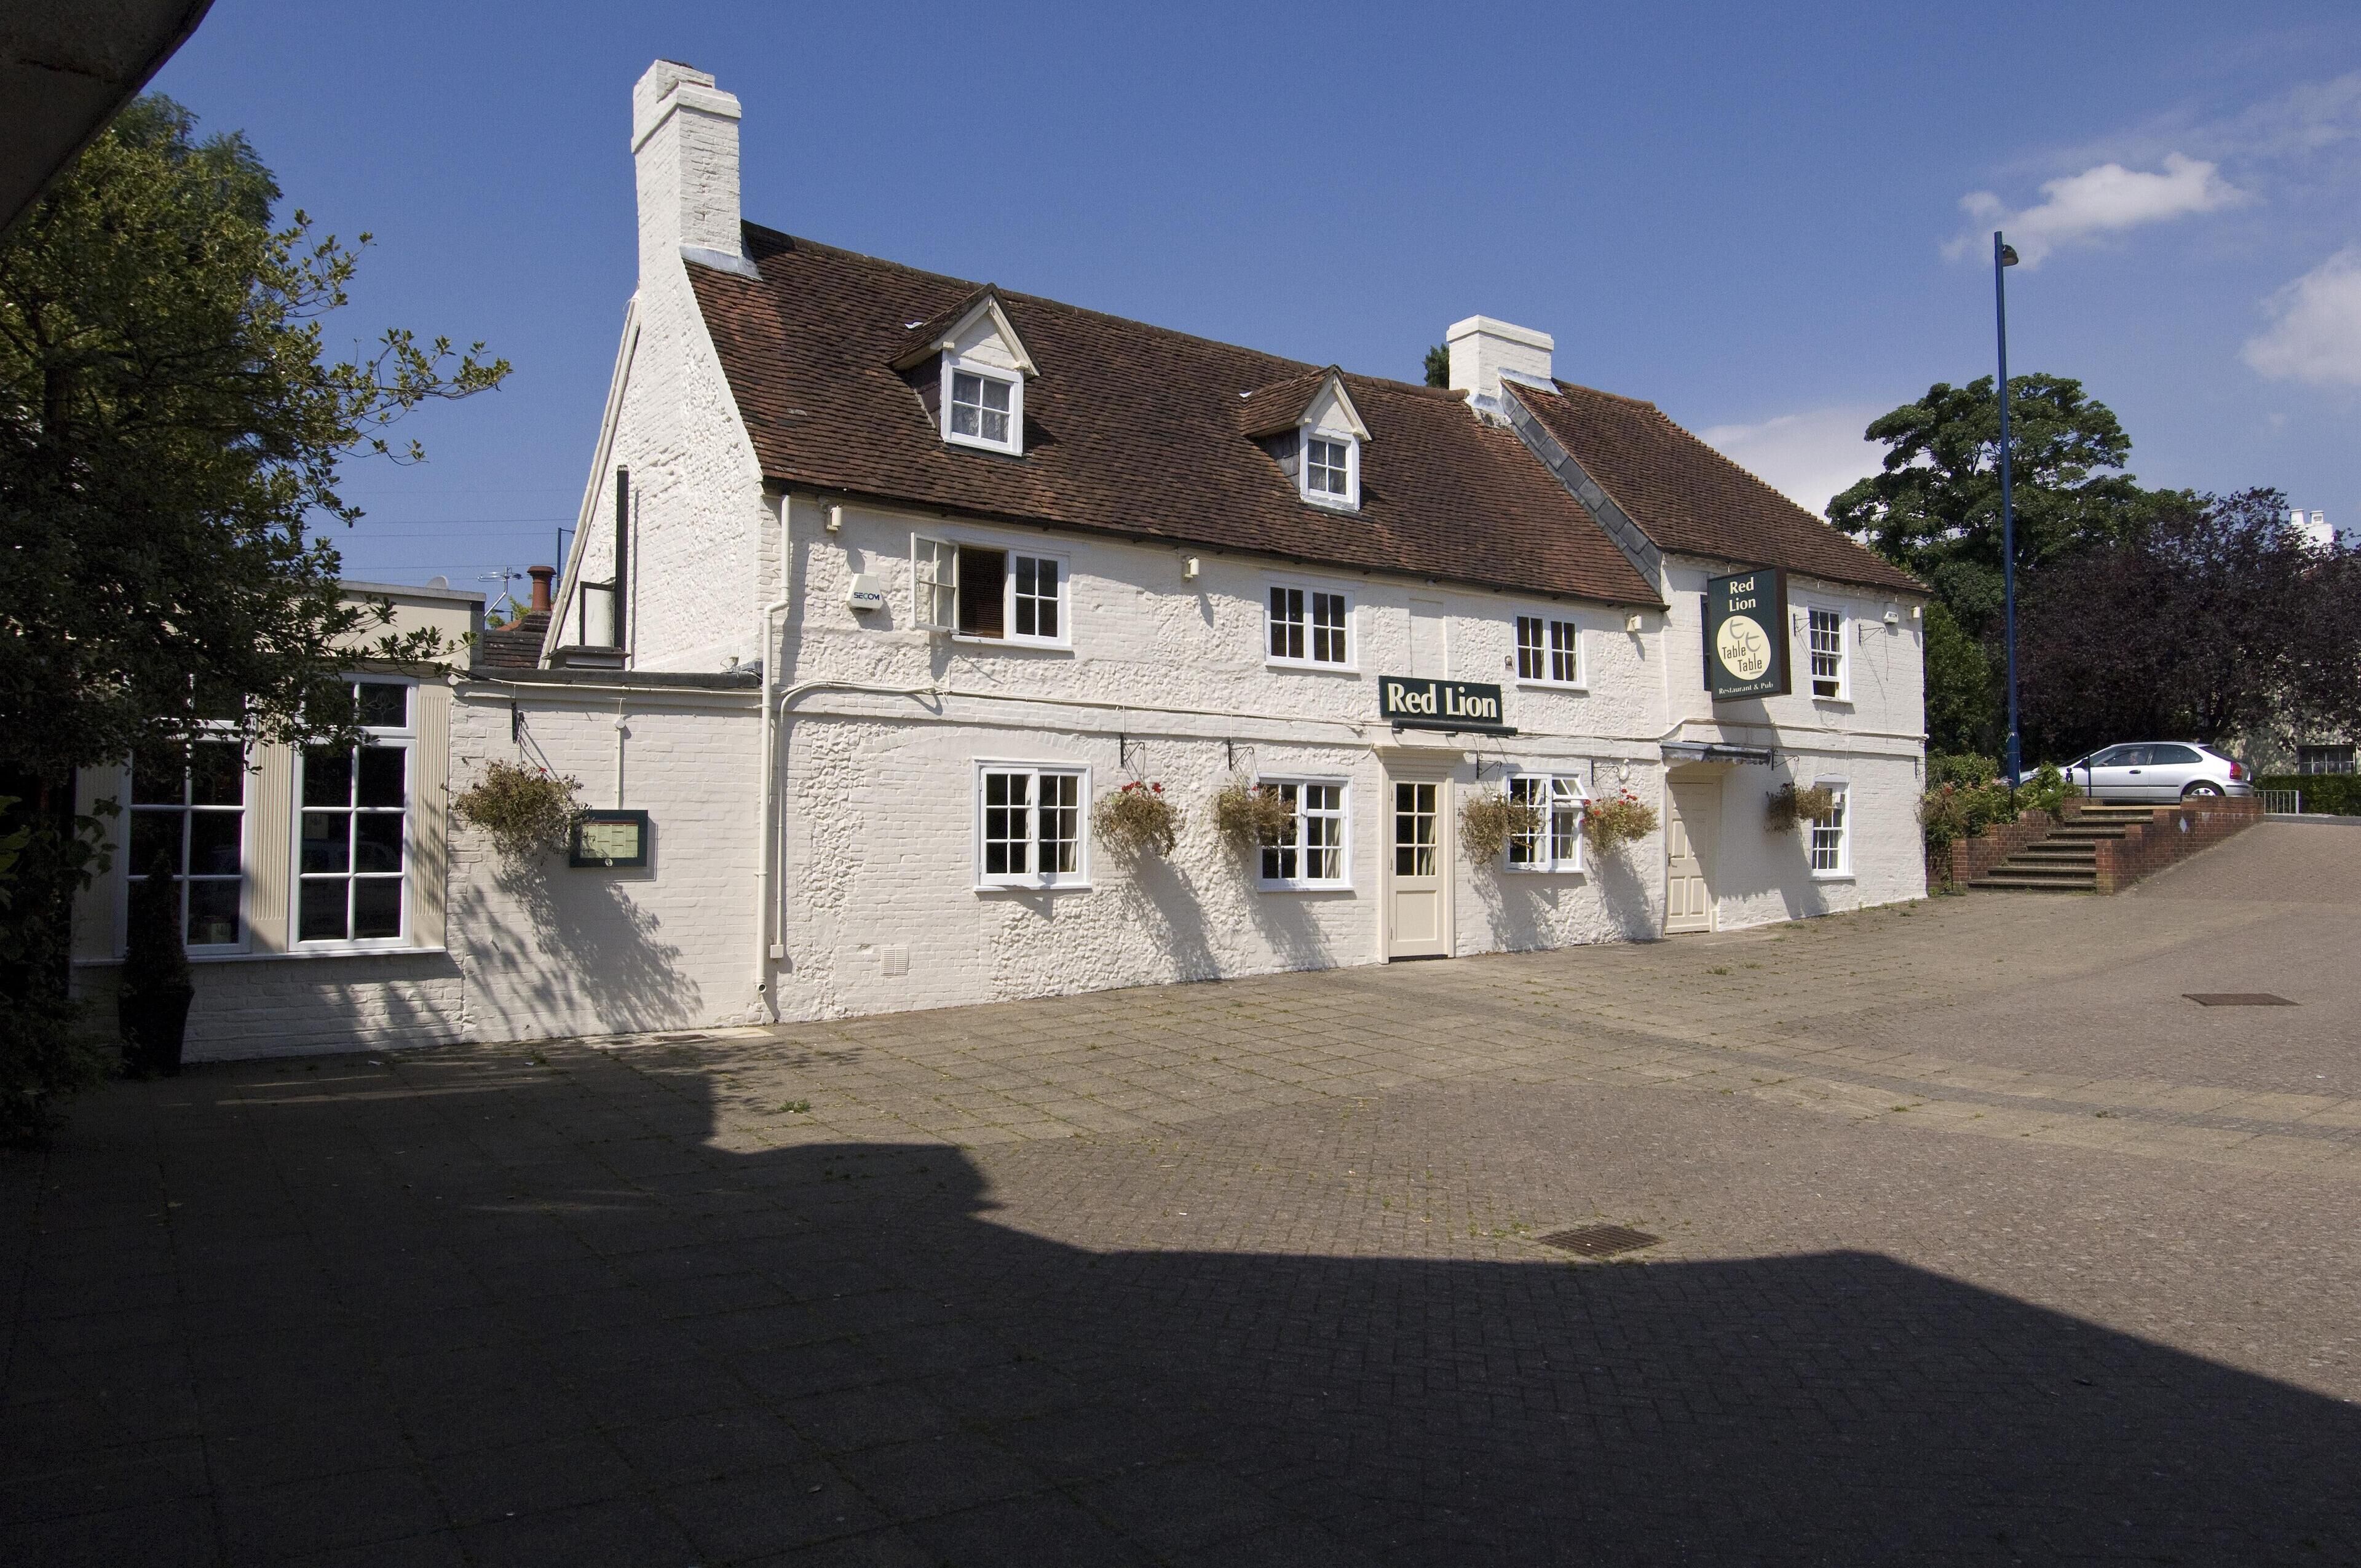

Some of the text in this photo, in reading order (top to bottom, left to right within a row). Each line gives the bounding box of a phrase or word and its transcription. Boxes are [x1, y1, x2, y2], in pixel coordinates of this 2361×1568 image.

[1730, 577, 1754, 595] Red
[853, 592, 880, 601] SECOM
[1729, 597, 1756, 612] Lion
[1722, 640, 1746, 660] Table
[1738, 652, 1762, 673] Table
[1718, 684, 1752, 694] Restaurant
[1388, 683, 1497, 718] Red Lion
